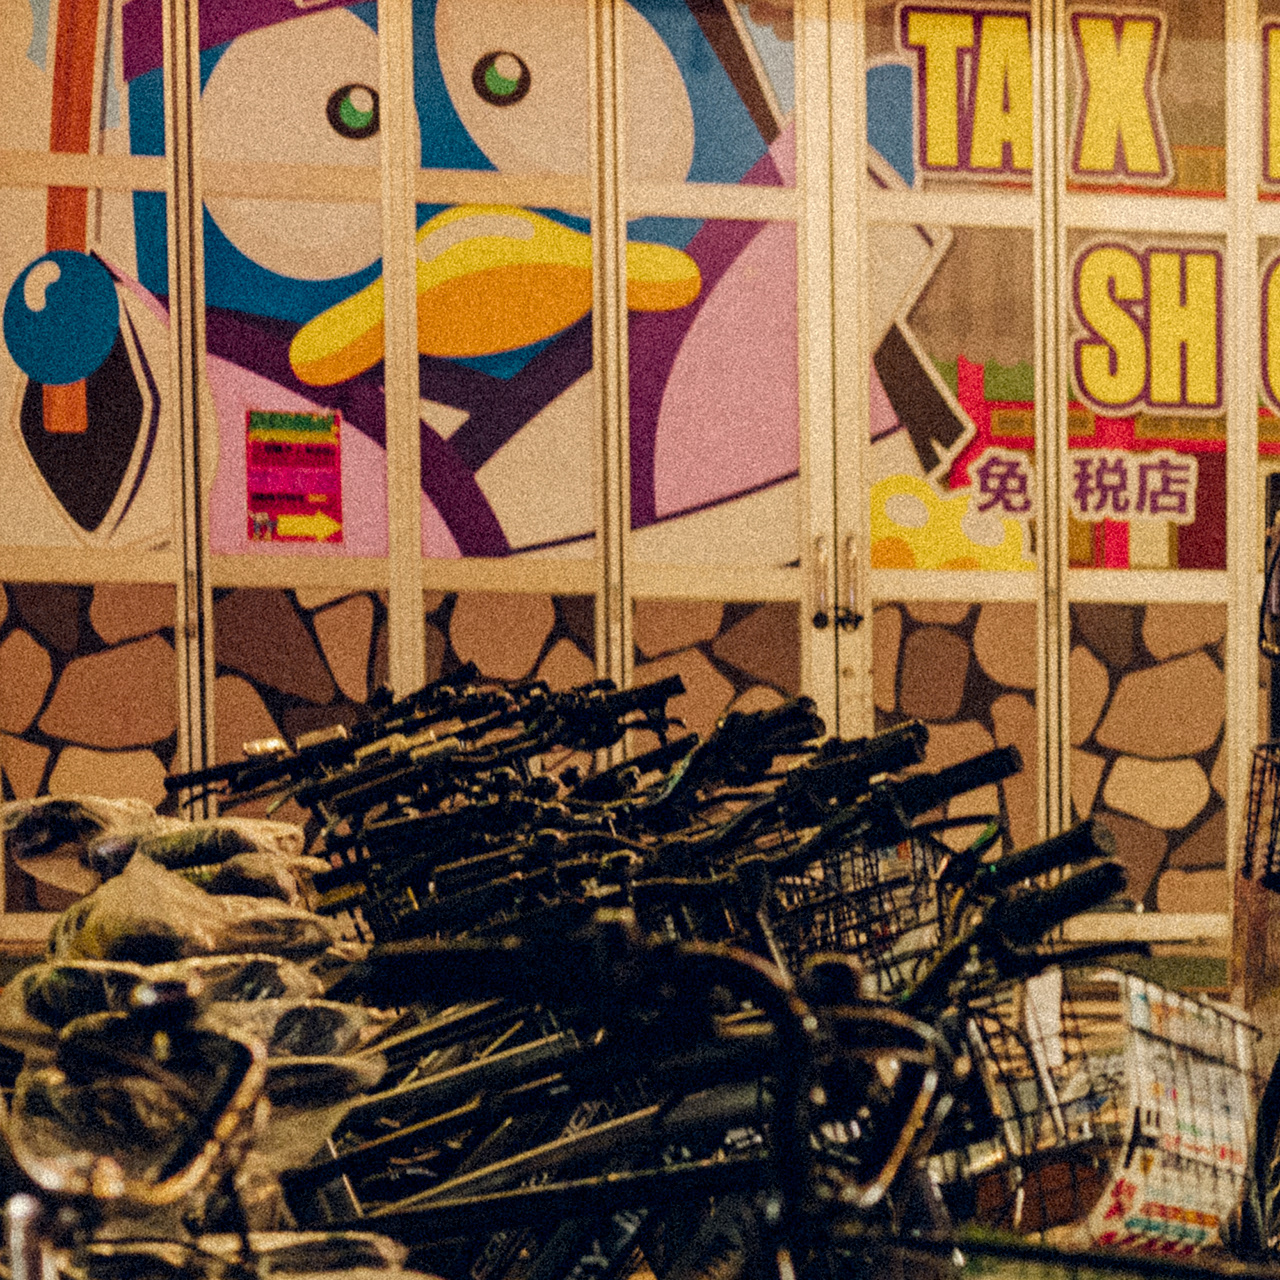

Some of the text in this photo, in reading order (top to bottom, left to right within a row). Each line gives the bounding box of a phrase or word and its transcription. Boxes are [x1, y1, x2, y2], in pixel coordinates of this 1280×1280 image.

[904, 9, 1171, 177] TAX
[976, 455, 1192, 514] 免税店
